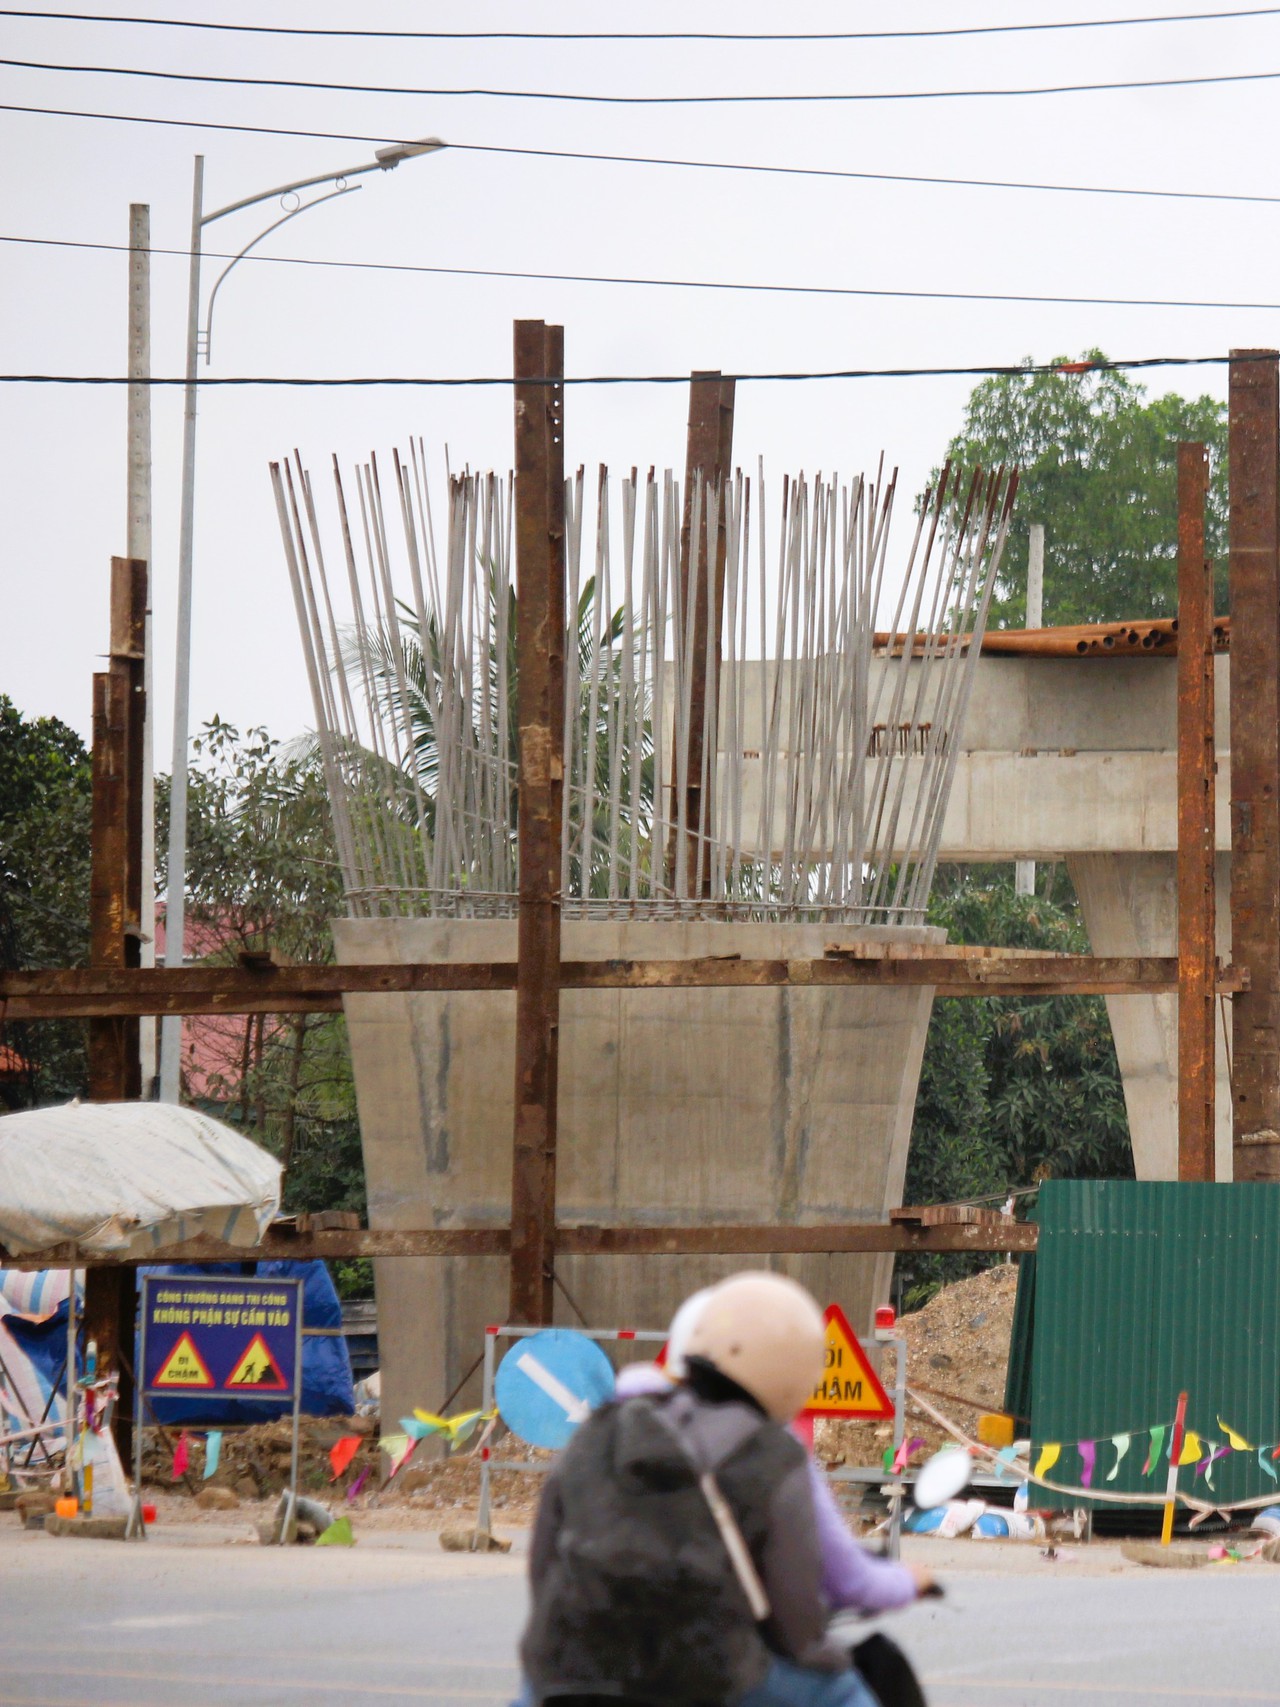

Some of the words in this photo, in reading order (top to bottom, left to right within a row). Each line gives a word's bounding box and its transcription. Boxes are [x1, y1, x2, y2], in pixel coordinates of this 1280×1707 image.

[157, 1291, 181, 1303] CÔNG
[246, 1294, 260, 1305] THI
[262, 1293, 287, 1306] CÔNG
[153, 1307, 191, 1324] KHÔNG
[192, 1308, 222, 1327] PHẬN
[224, 1310, 240, 1328] SỰ
[268, 1310, 290, 1326] VÀO
[813, 1377, 862, 1404] HẬM
